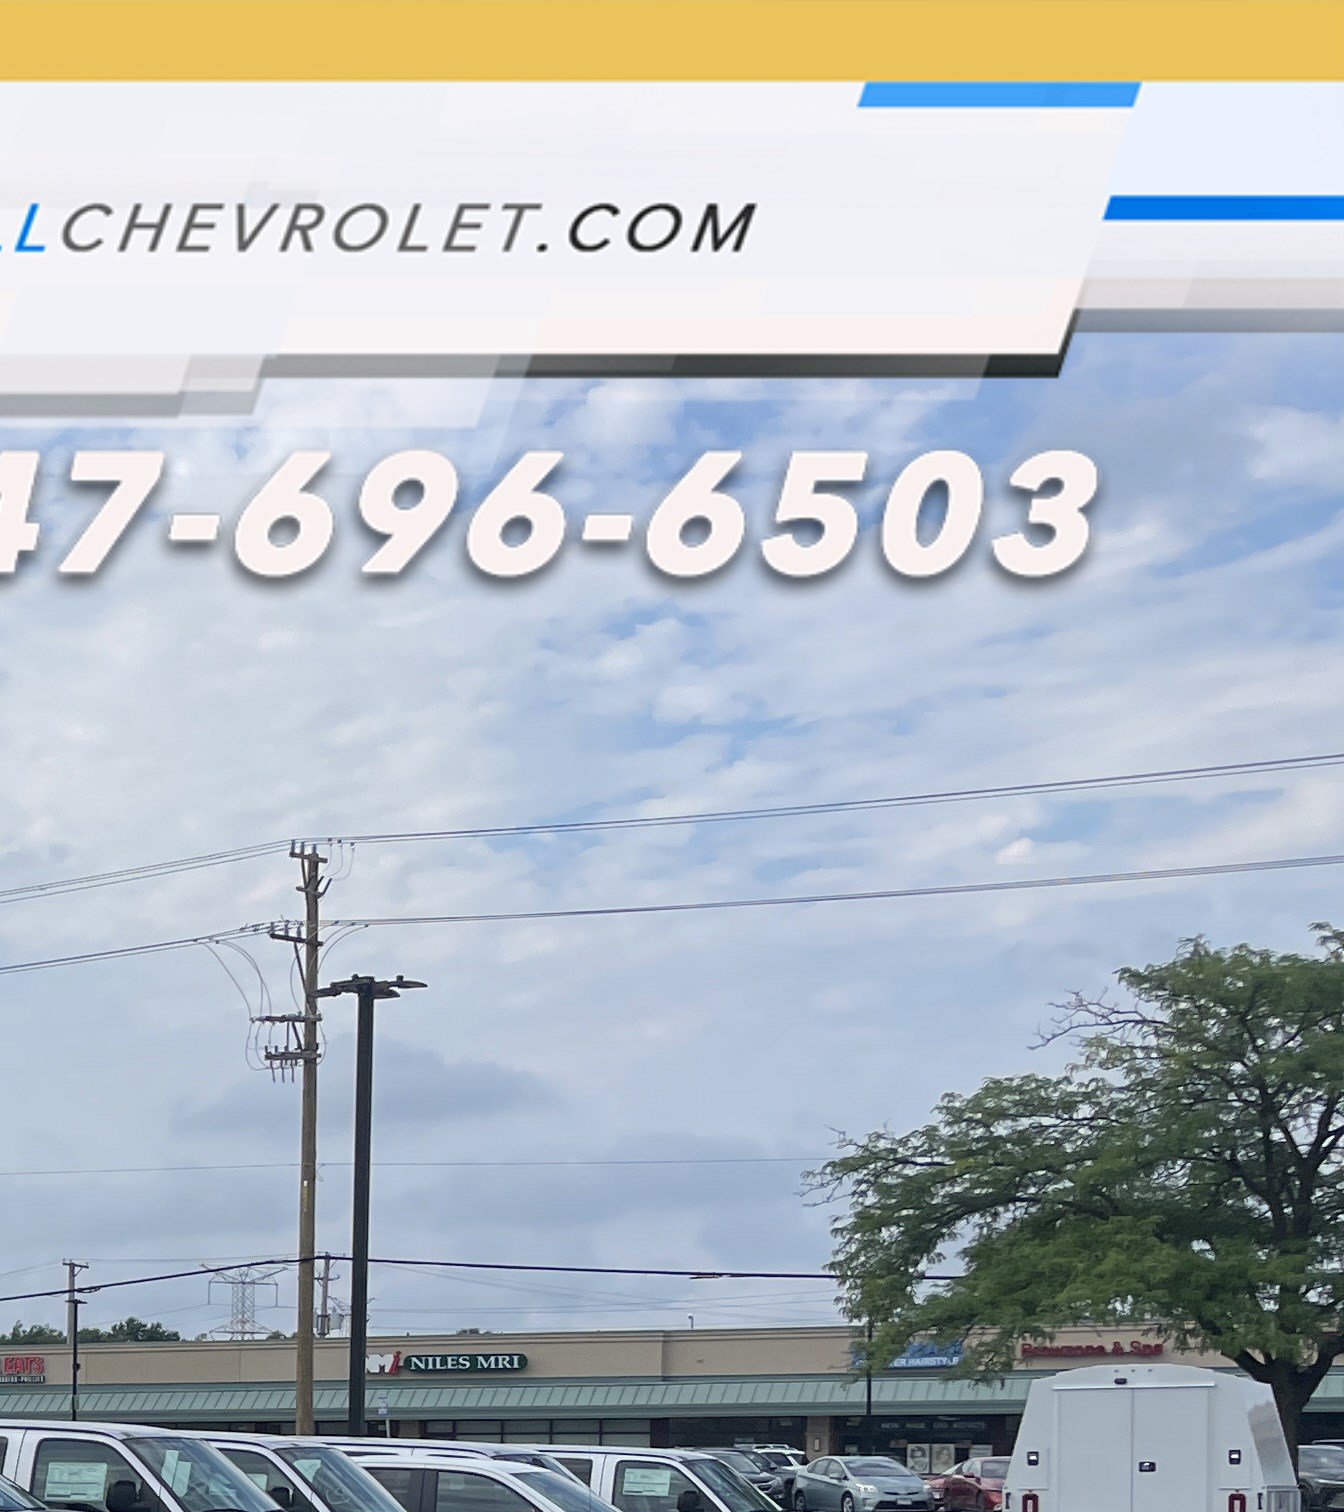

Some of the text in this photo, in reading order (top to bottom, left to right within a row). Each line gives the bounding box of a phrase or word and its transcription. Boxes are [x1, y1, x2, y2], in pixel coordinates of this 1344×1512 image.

[4, 1356, 45, 1375] EATS
[410, 1355, 521, 1370] NILES MRI
